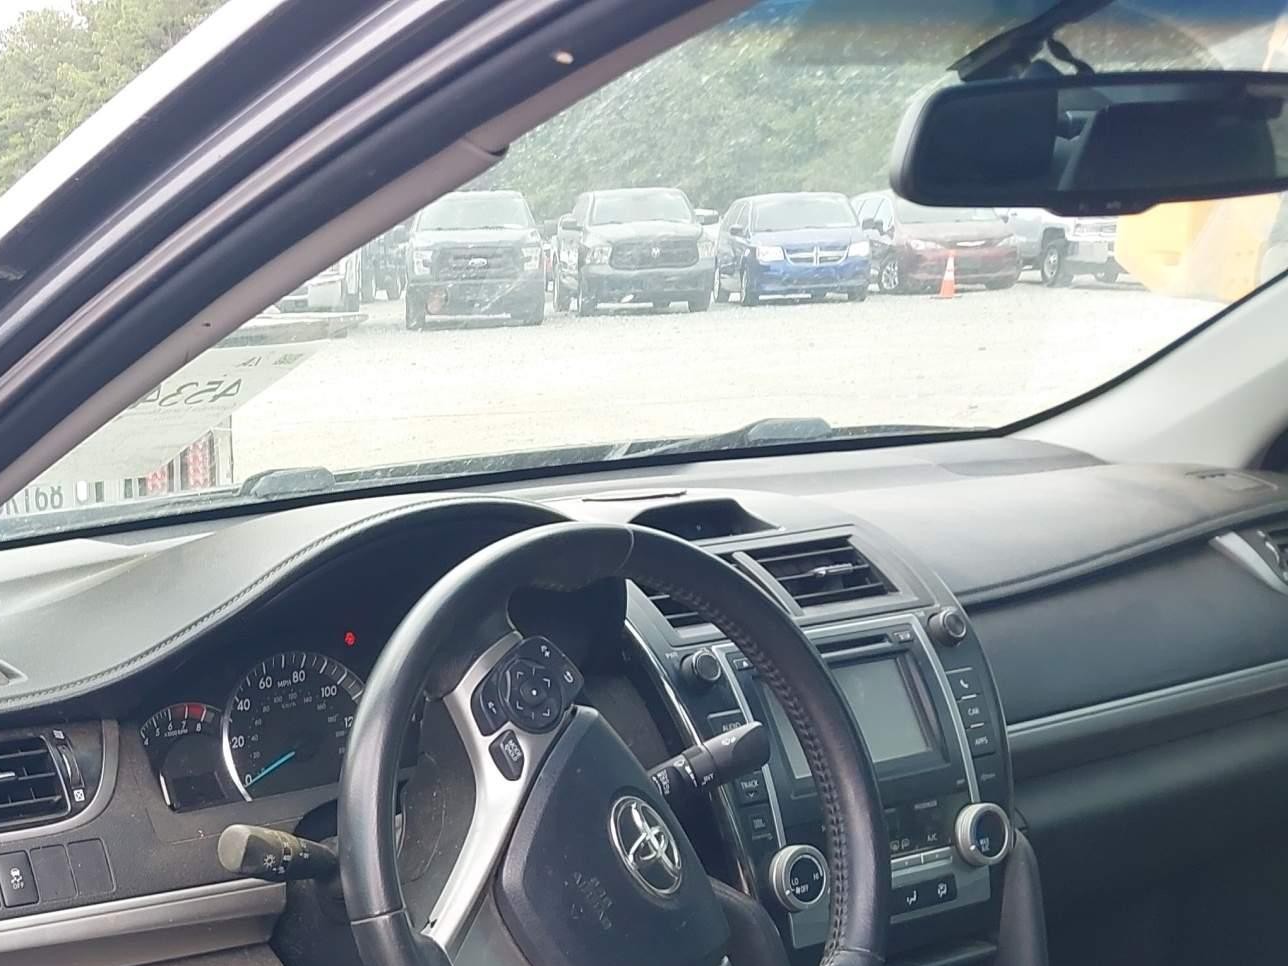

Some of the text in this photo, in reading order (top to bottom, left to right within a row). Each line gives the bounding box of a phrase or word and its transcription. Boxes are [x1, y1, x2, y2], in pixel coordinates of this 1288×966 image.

[292, 670, 305, 683] 80
[259, 676, 272, 689] 60
[320, 685, 337, 698] 100
[237, 699, 251, 712] 40
[167, 720, 173, 731] 6
[182, 720, 187, 729] 7
[196, 722, 202, 732] 8
[155, 728, 160, 737] 5
[143, 738, 149, 746] 4
[232, 735, 245, 749] 20
[244, 774, 252, 785] 0
